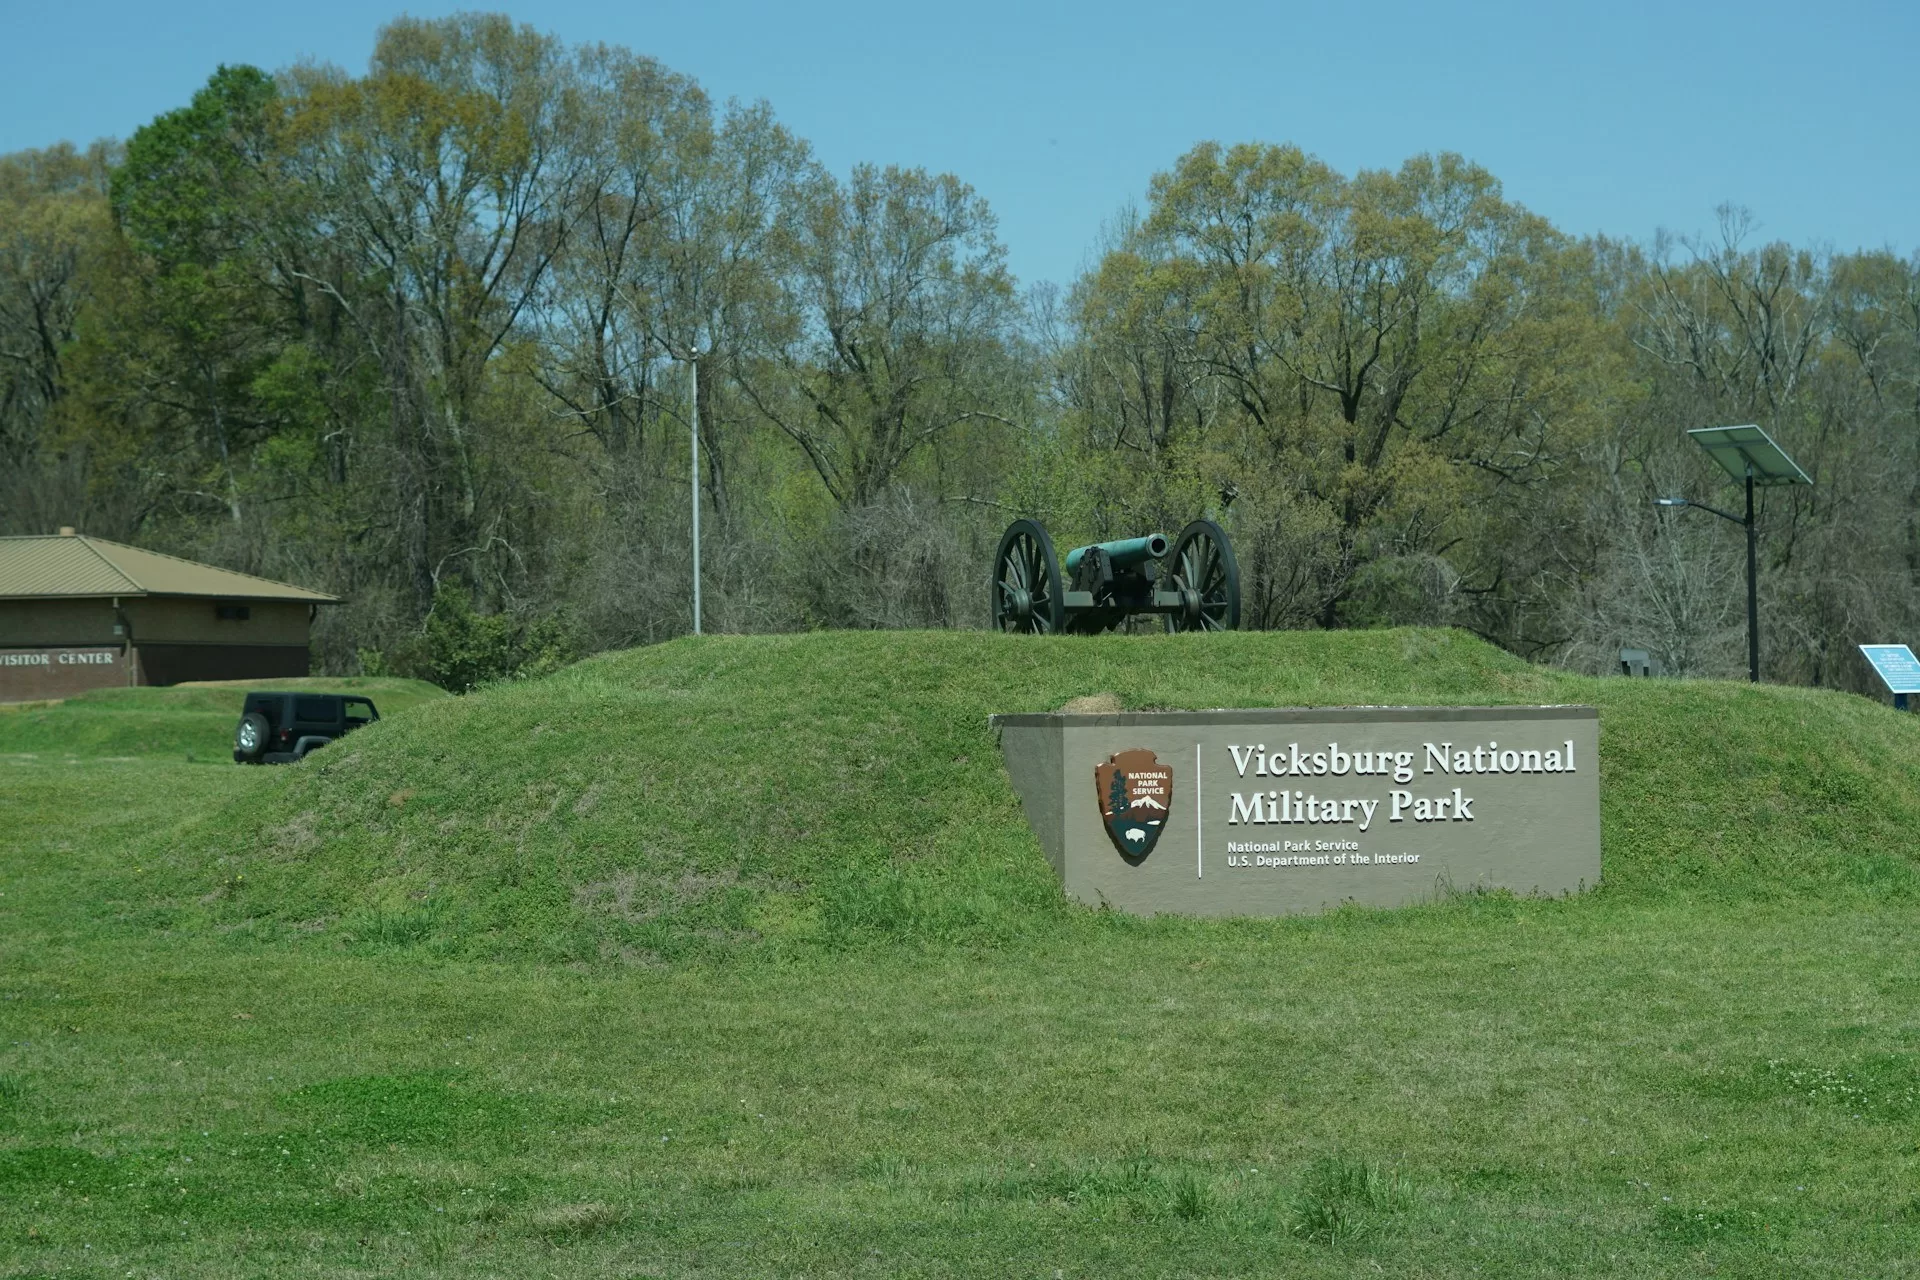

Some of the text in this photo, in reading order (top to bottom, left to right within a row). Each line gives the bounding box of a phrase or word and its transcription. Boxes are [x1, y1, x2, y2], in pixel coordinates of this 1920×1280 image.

[58, 653, 113, 664] CENTER
[1228, 740, 1577, 784] Vicksburg National
[1228, 788, 1475, 831] Military Park
[1227, 839, 1359, 853] National Park Service
[1228, 852, 1421, 868] U.S. Department of the Interior
